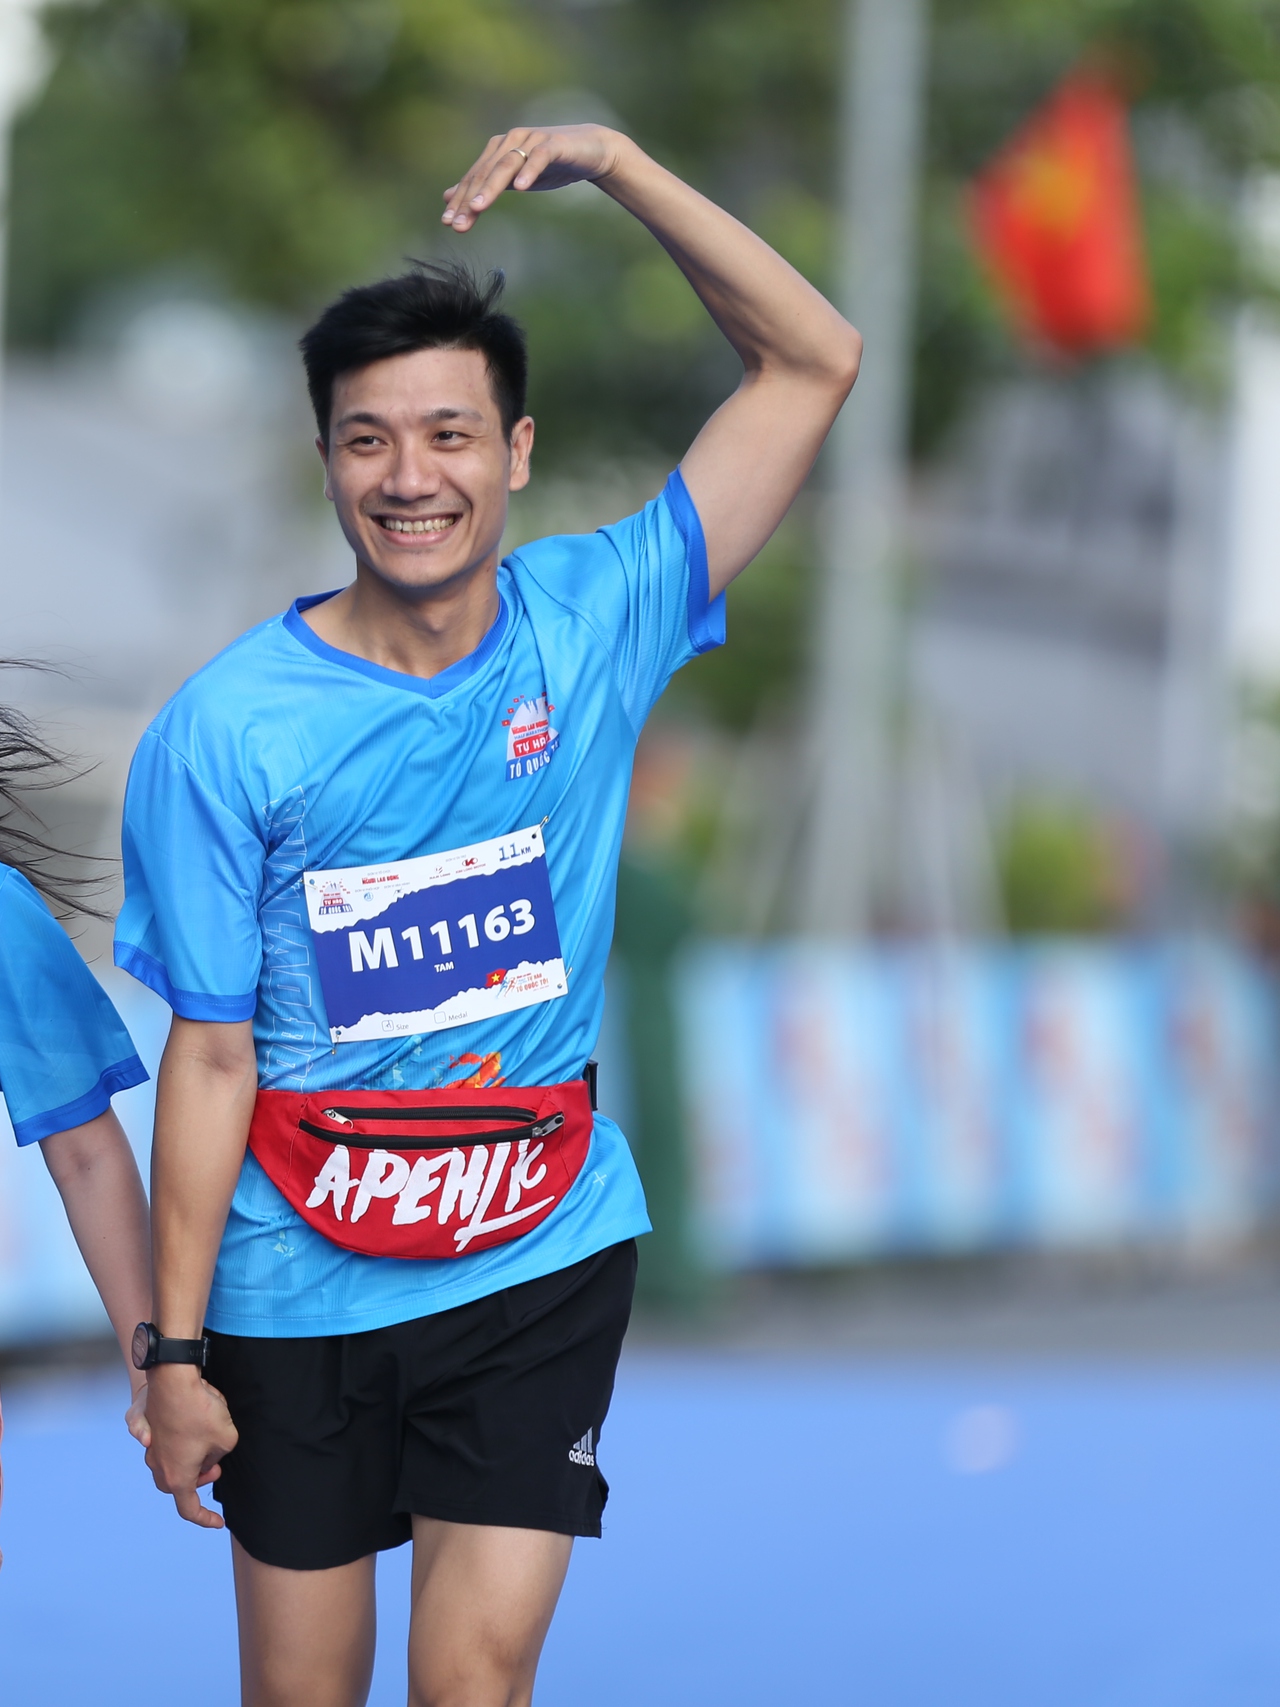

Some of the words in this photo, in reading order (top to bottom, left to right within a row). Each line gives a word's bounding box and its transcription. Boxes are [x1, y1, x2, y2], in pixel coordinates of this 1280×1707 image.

[348, 898, 536, 973] M11163
[434, 961, 454, 973] TAM
[448, 1011, 468, 1021] Medal
[569, 1449, 595, 1467] adidas
